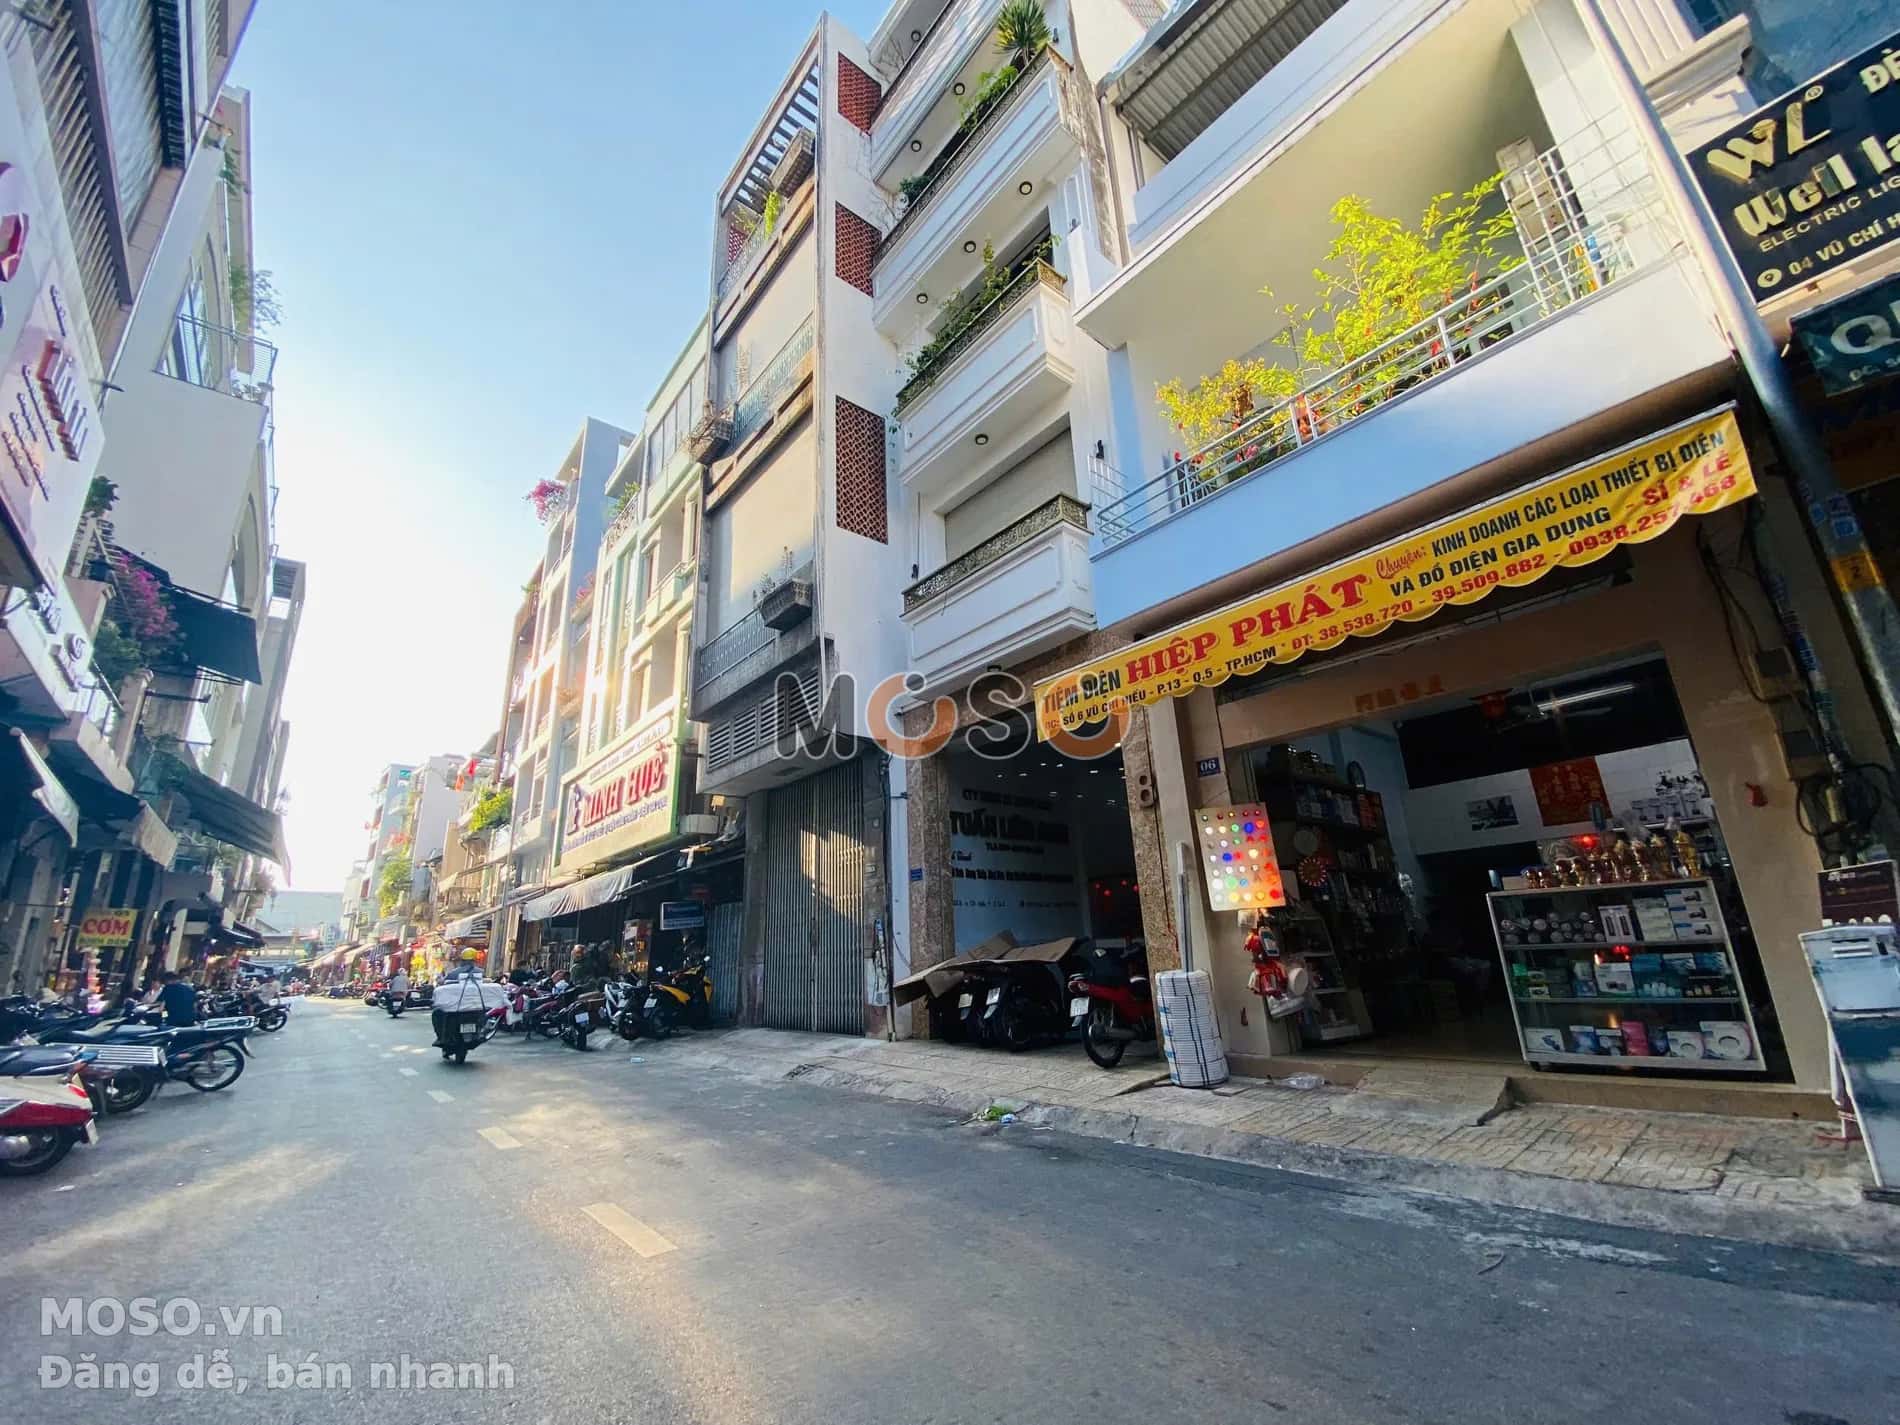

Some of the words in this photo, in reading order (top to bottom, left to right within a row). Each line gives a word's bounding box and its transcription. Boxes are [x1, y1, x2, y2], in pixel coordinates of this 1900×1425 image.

[1734, 153, 1856, 238] Well
[1759, 195, 1861, 253] ELECTRIC
[1788, 256, 1814, 276] 04
[1847, 219, 1884, 248] CHÍ
[1432, 530, 1467, 557] KINH
[1470, 510, 1521, 543] DOANH
[1524, 497, 1557, 523] CÁC
[1560, 480, 1600, 511] LOẠI
[1601, 457, 1650, 492] THIẾT
[1655, 450, 1678, 473] BỊ
[1376, 546, 1427, 579] Chuyên:
[1390, 575, 1415, 597] VÀ
[1450, 547, 1498, 576] ĐIỆN
[1503, 533, 1541, 558] GIA
[1545, 506, 1612, 542] DỤNG
[1063, 713, 1075, 726] SỐ
[1077, 710, 1084, 721] 6
[1086, 704, 1099, 719] VŨ
[1157, 678, 1181, 695] P.13
[1192, 666, 1213, 685] Q.5
[1225, 646, 1277, 672] TP.HCM
[1291, 635, 1314, 651] ĐT:
[1319, 599, 1413, 643] 38.538.720
[1432, 553, 1547, 602] 39.509.882
[1081, 669, 1121, 701] ĐIỆN
[1126, 634, 1218, 684] HIỆP
[1231, 573, 1371, 647] PHÁT
[1200, 759, 1217, 771] 06
